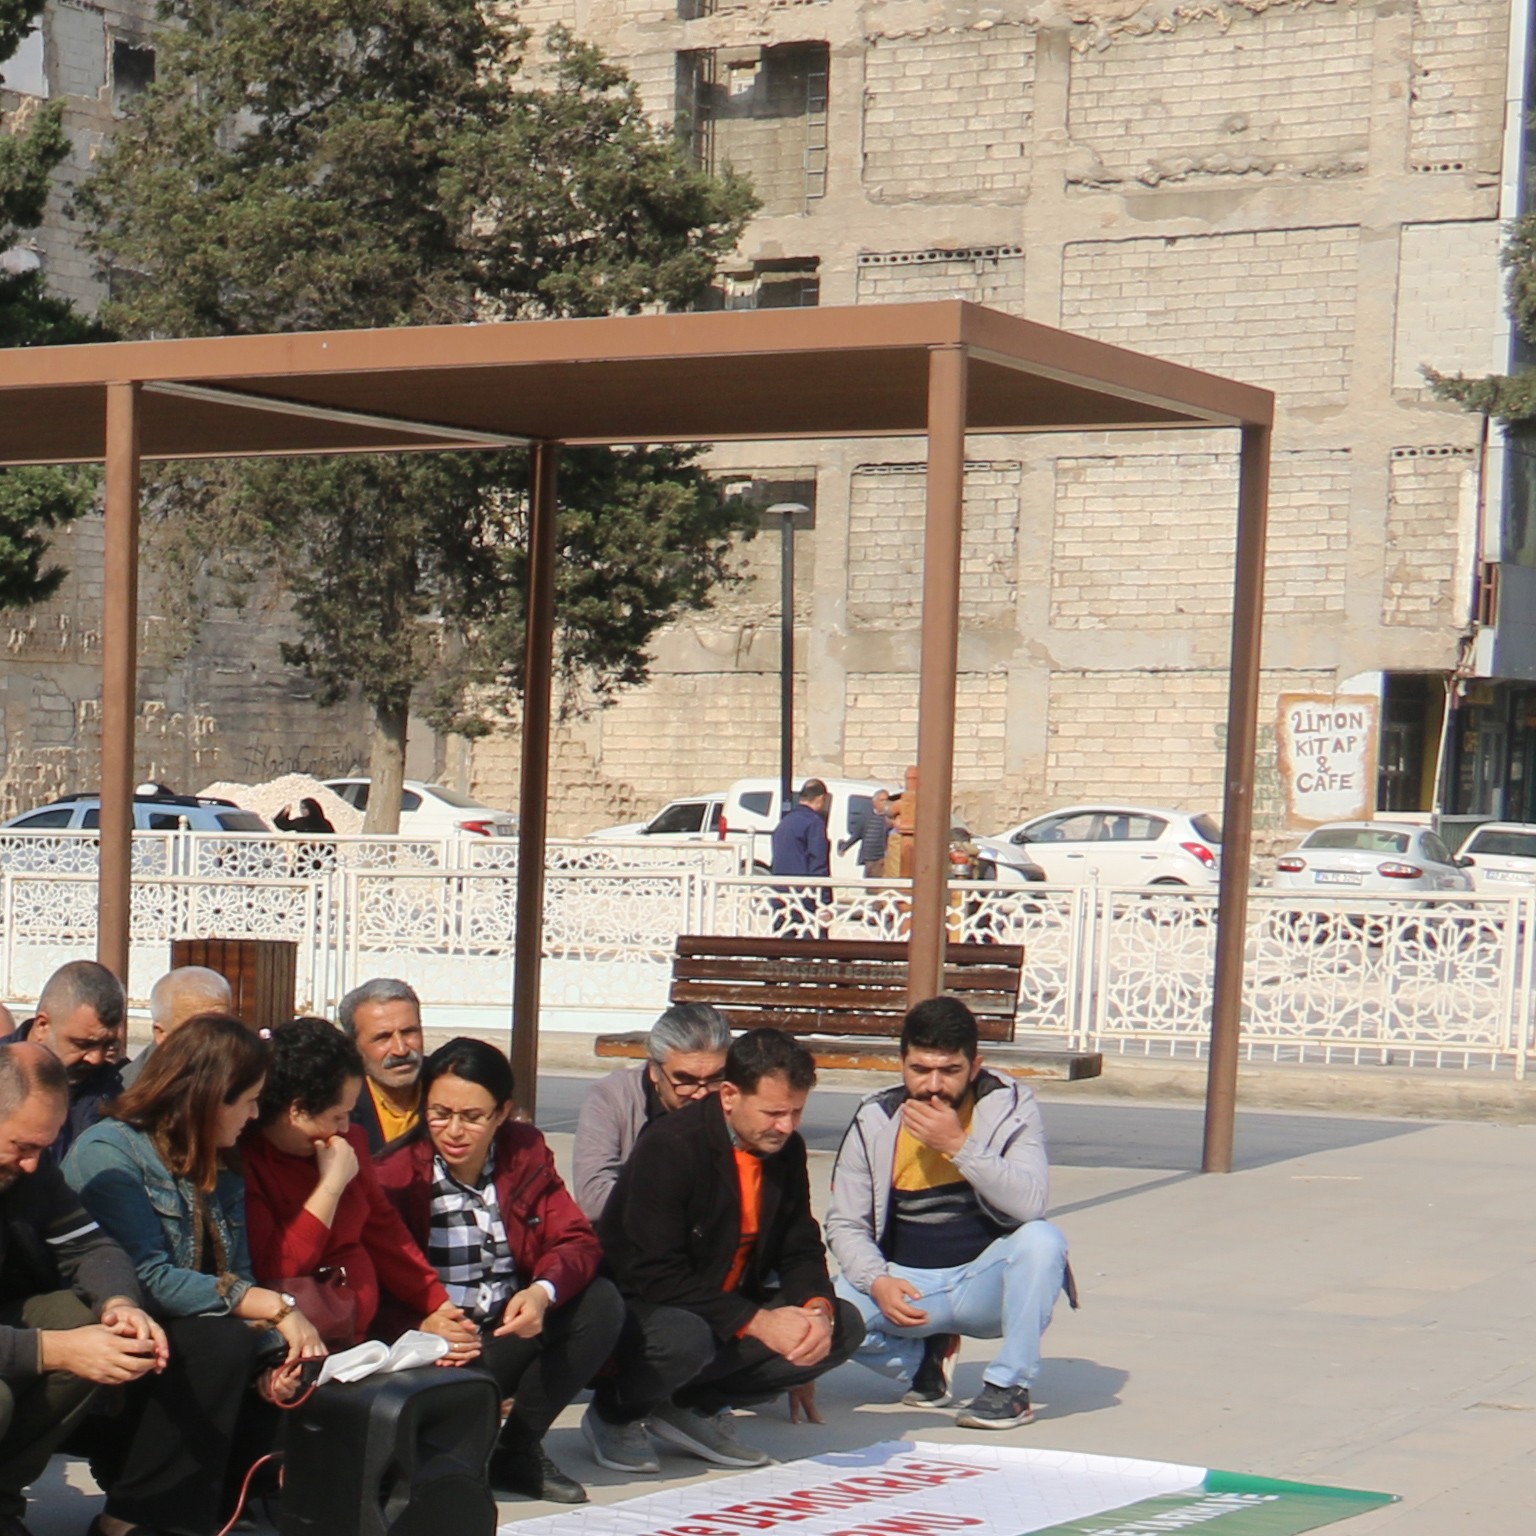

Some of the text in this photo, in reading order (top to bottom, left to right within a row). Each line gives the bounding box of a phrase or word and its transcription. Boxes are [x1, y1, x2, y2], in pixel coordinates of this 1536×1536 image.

[1316, 755, 1331, 776] &
[1296, 772, 1357, 794] CAFE
[689, 1457, 1000, 1529] DEMOKRASİ
